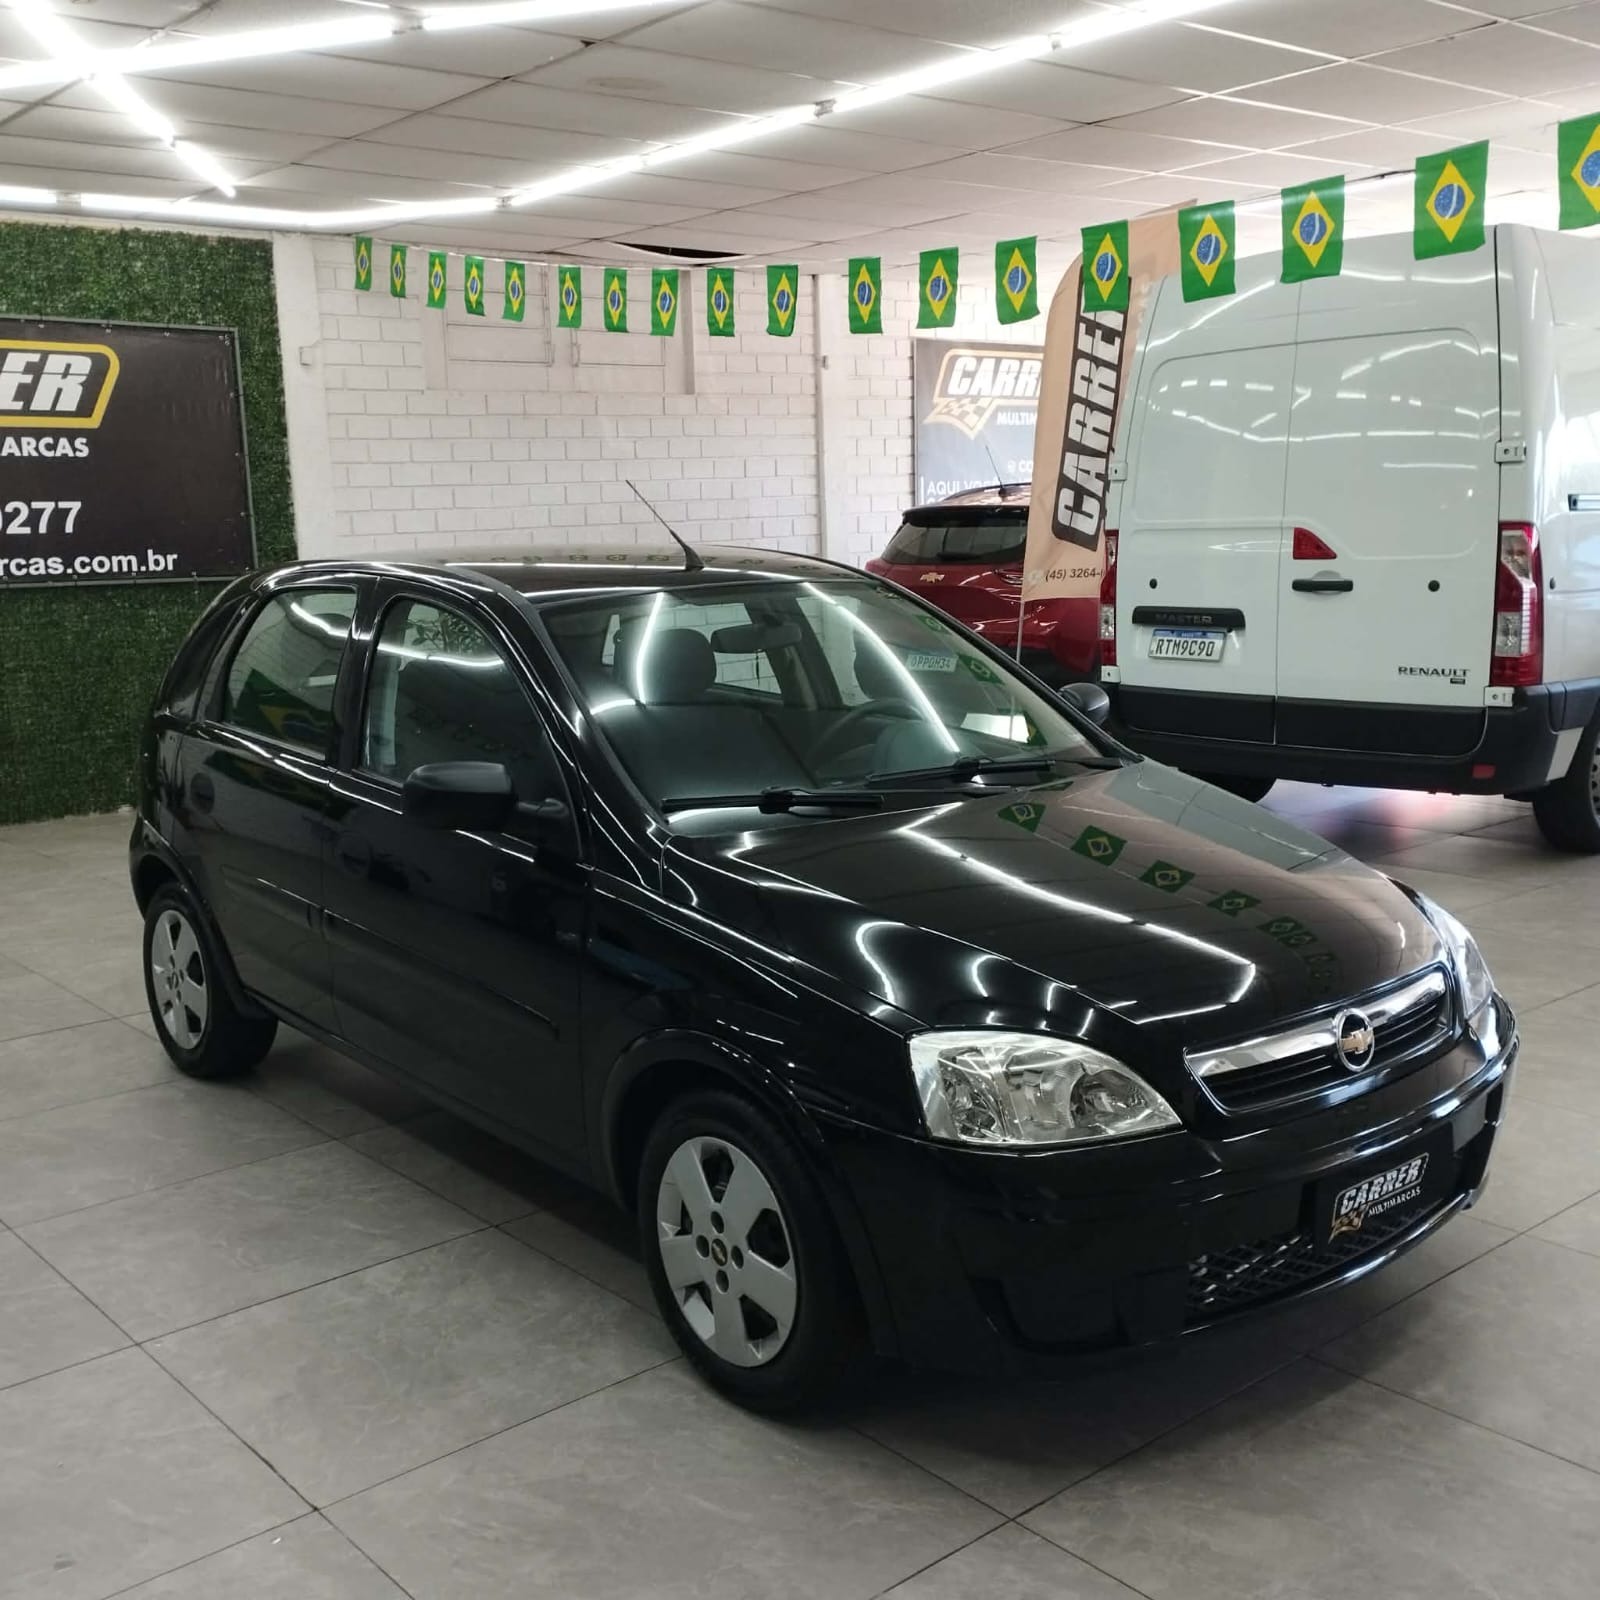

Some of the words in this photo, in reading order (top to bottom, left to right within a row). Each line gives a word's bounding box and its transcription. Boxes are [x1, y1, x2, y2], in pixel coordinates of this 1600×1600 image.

[1, 437, 89, 457] ARCAS
[0, 501, 82, 534] 277
[1045, 568, 1067, 582] (45)
[1398, 666, 1470, 678] RENAULT
[1340, 1158, 1422, 1216] CARRER
[1367, 1186, 1421, 1217] MULTIMARCAS
